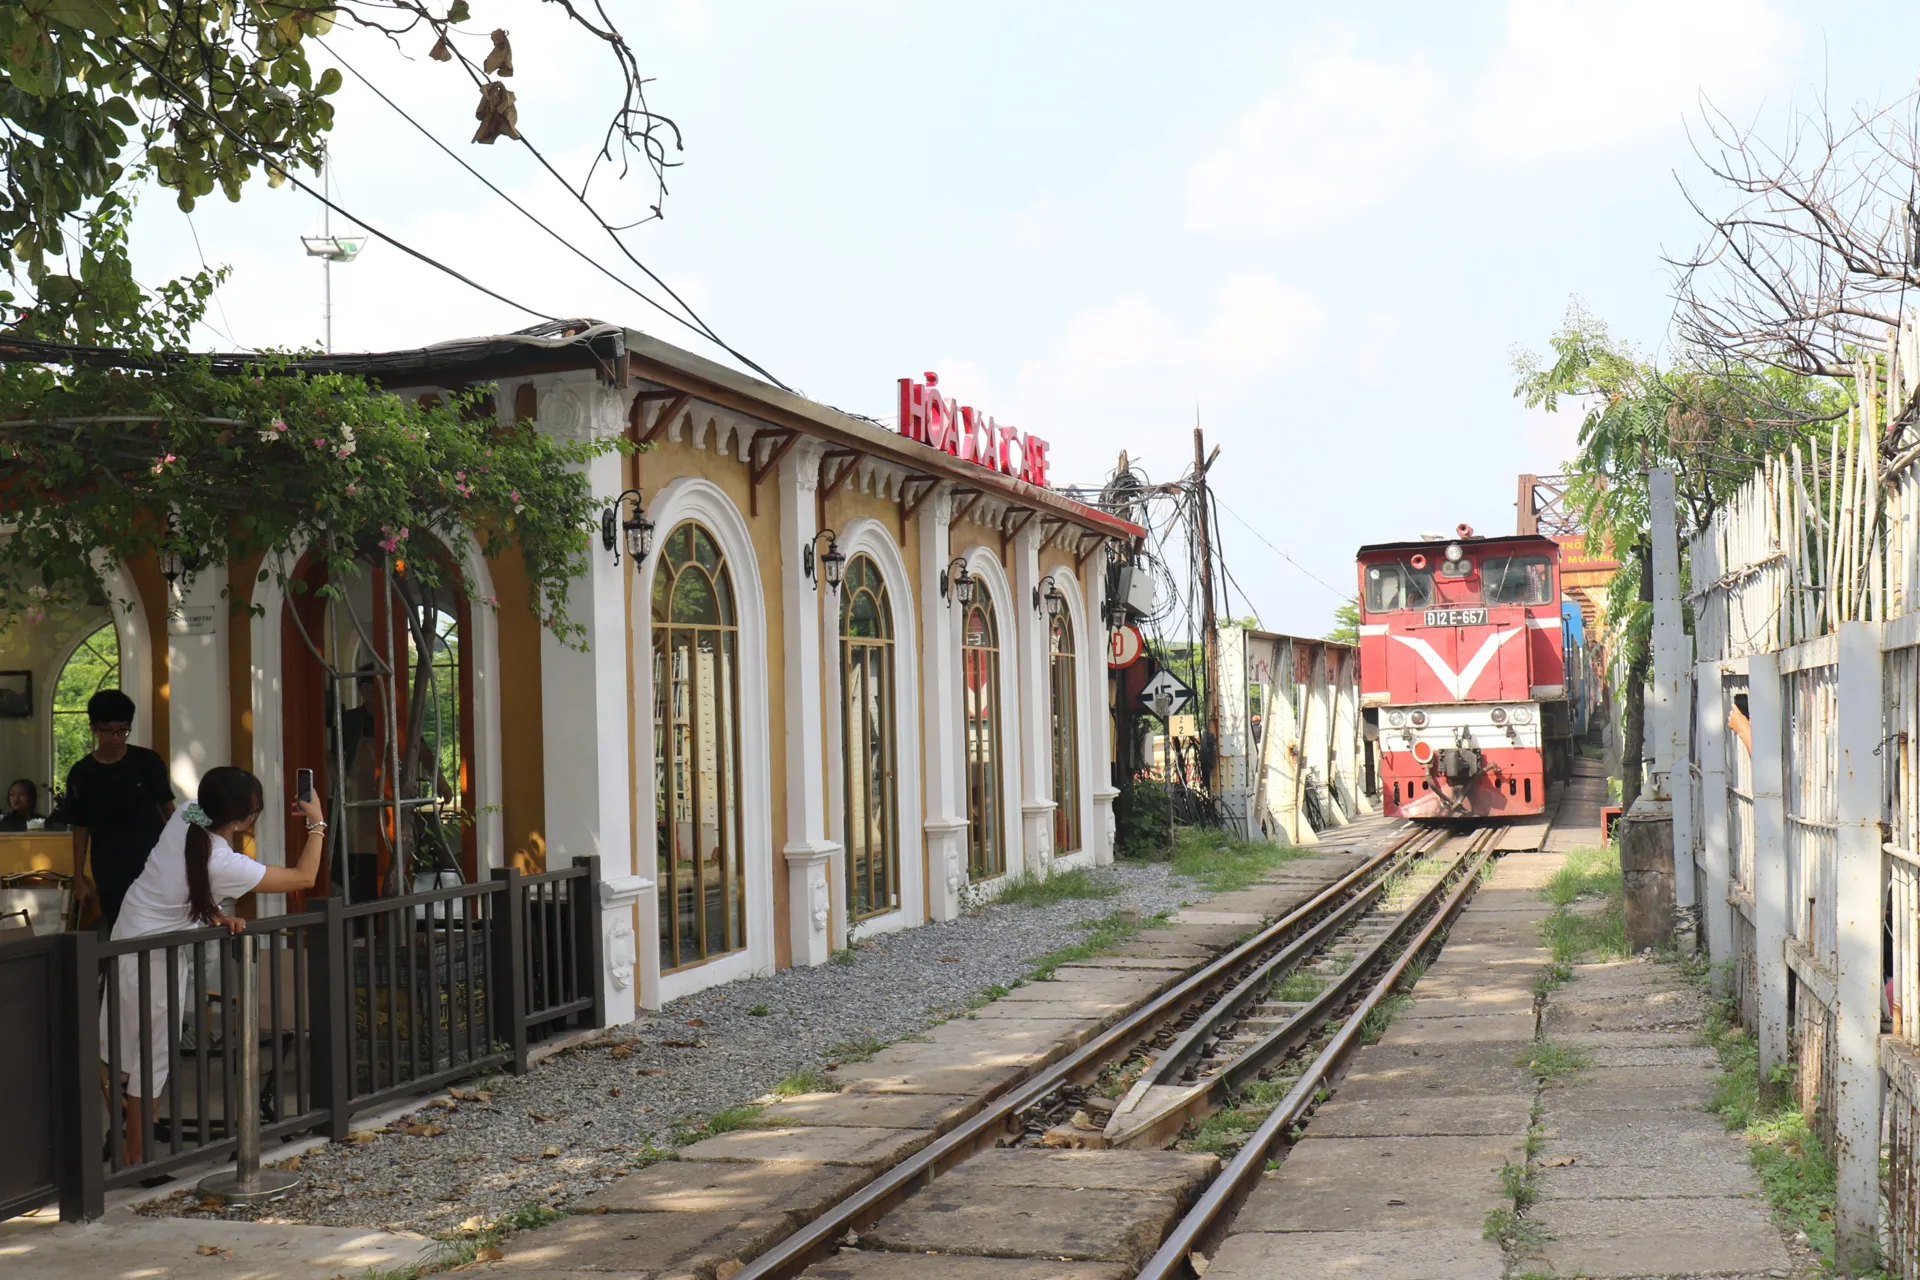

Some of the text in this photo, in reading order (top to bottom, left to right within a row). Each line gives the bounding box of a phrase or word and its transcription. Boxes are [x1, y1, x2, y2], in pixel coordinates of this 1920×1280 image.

[961, 406, 998, 472] XA
[1000, 426, 1051, 488] CAFE
[1560, 538, 1585, 550] THÔ
[1179, 716, 1184, 724] 2
[1179, 726, 1184, 735] 2
